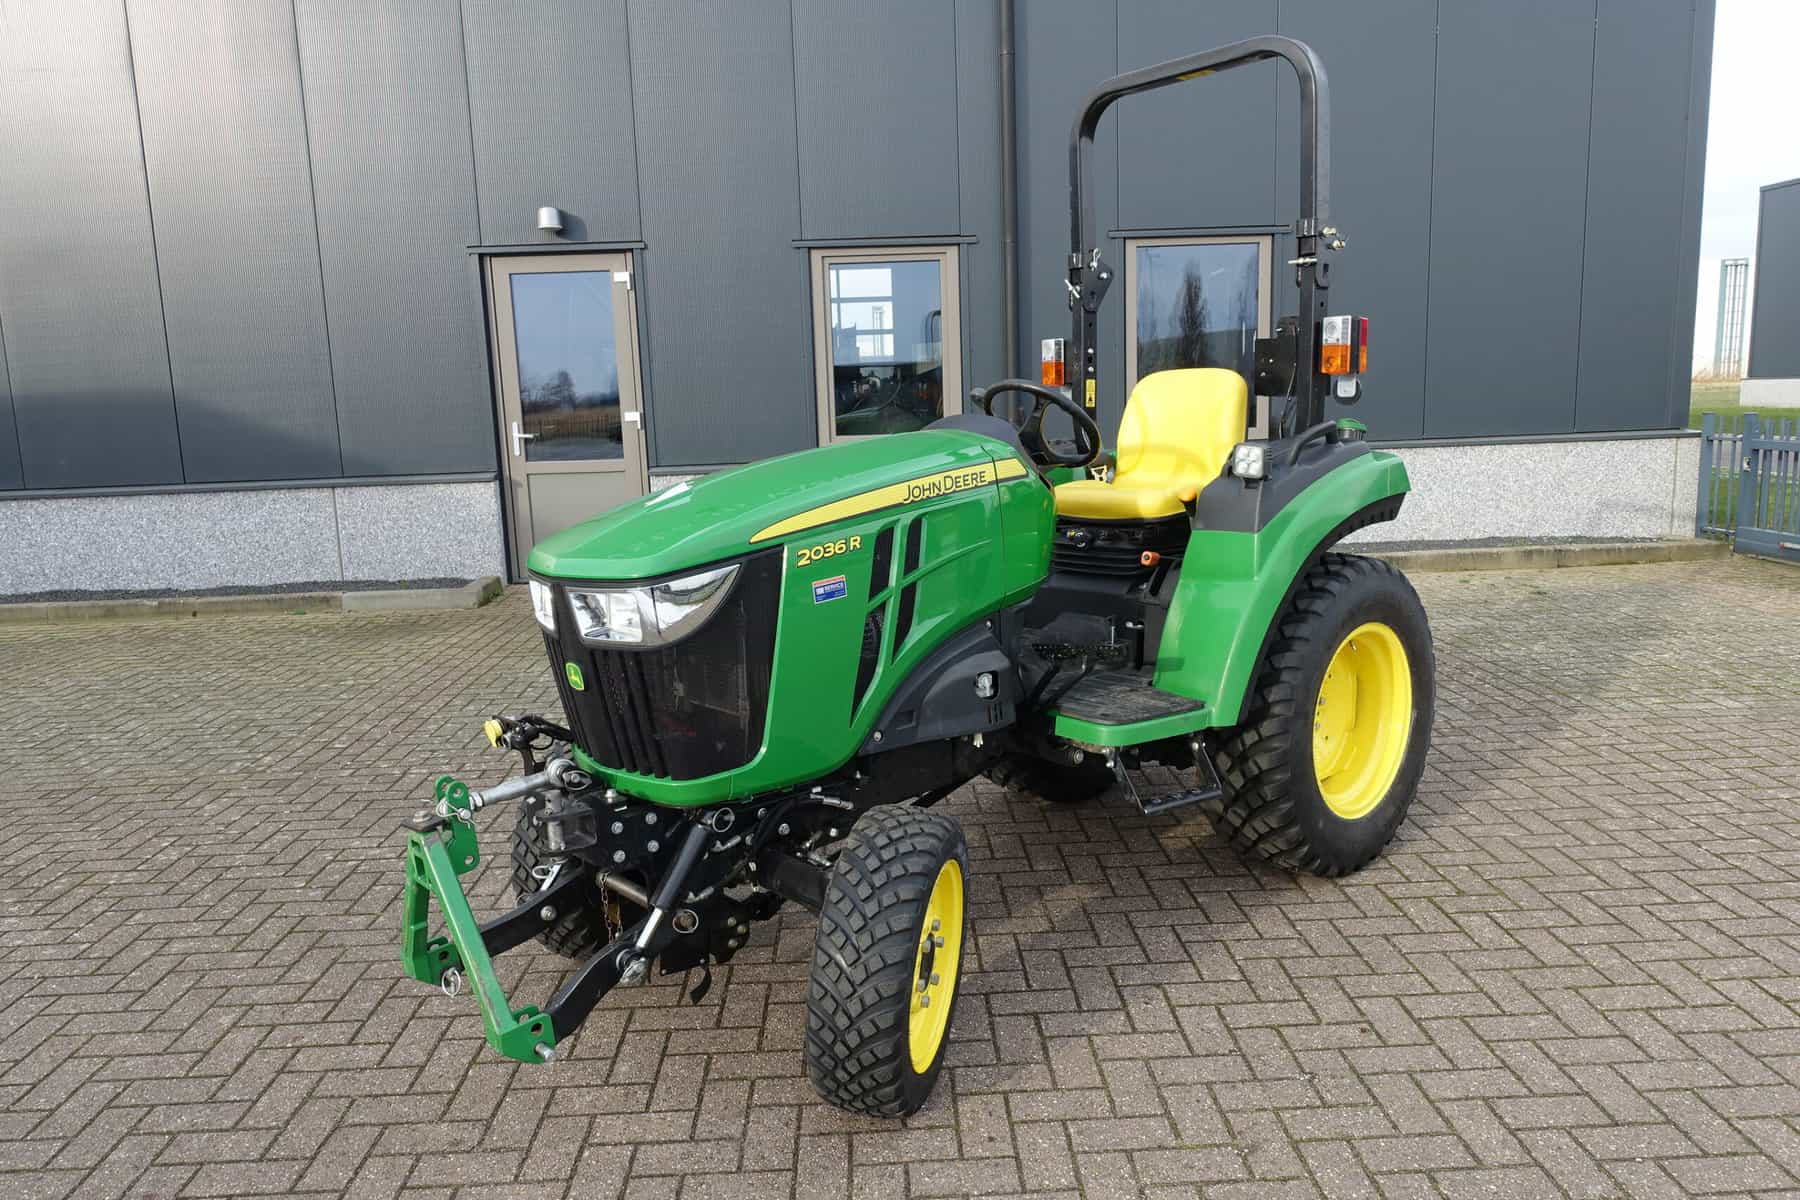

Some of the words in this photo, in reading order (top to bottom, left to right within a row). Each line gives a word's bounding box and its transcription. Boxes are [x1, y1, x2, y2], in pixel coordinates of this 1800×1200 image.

[903, 480, 942, 502] JOHN
[943, 471, 987, 491] DEERE
[797, 540, 847, 567] 2036
[849, 535, 862, 551] R
